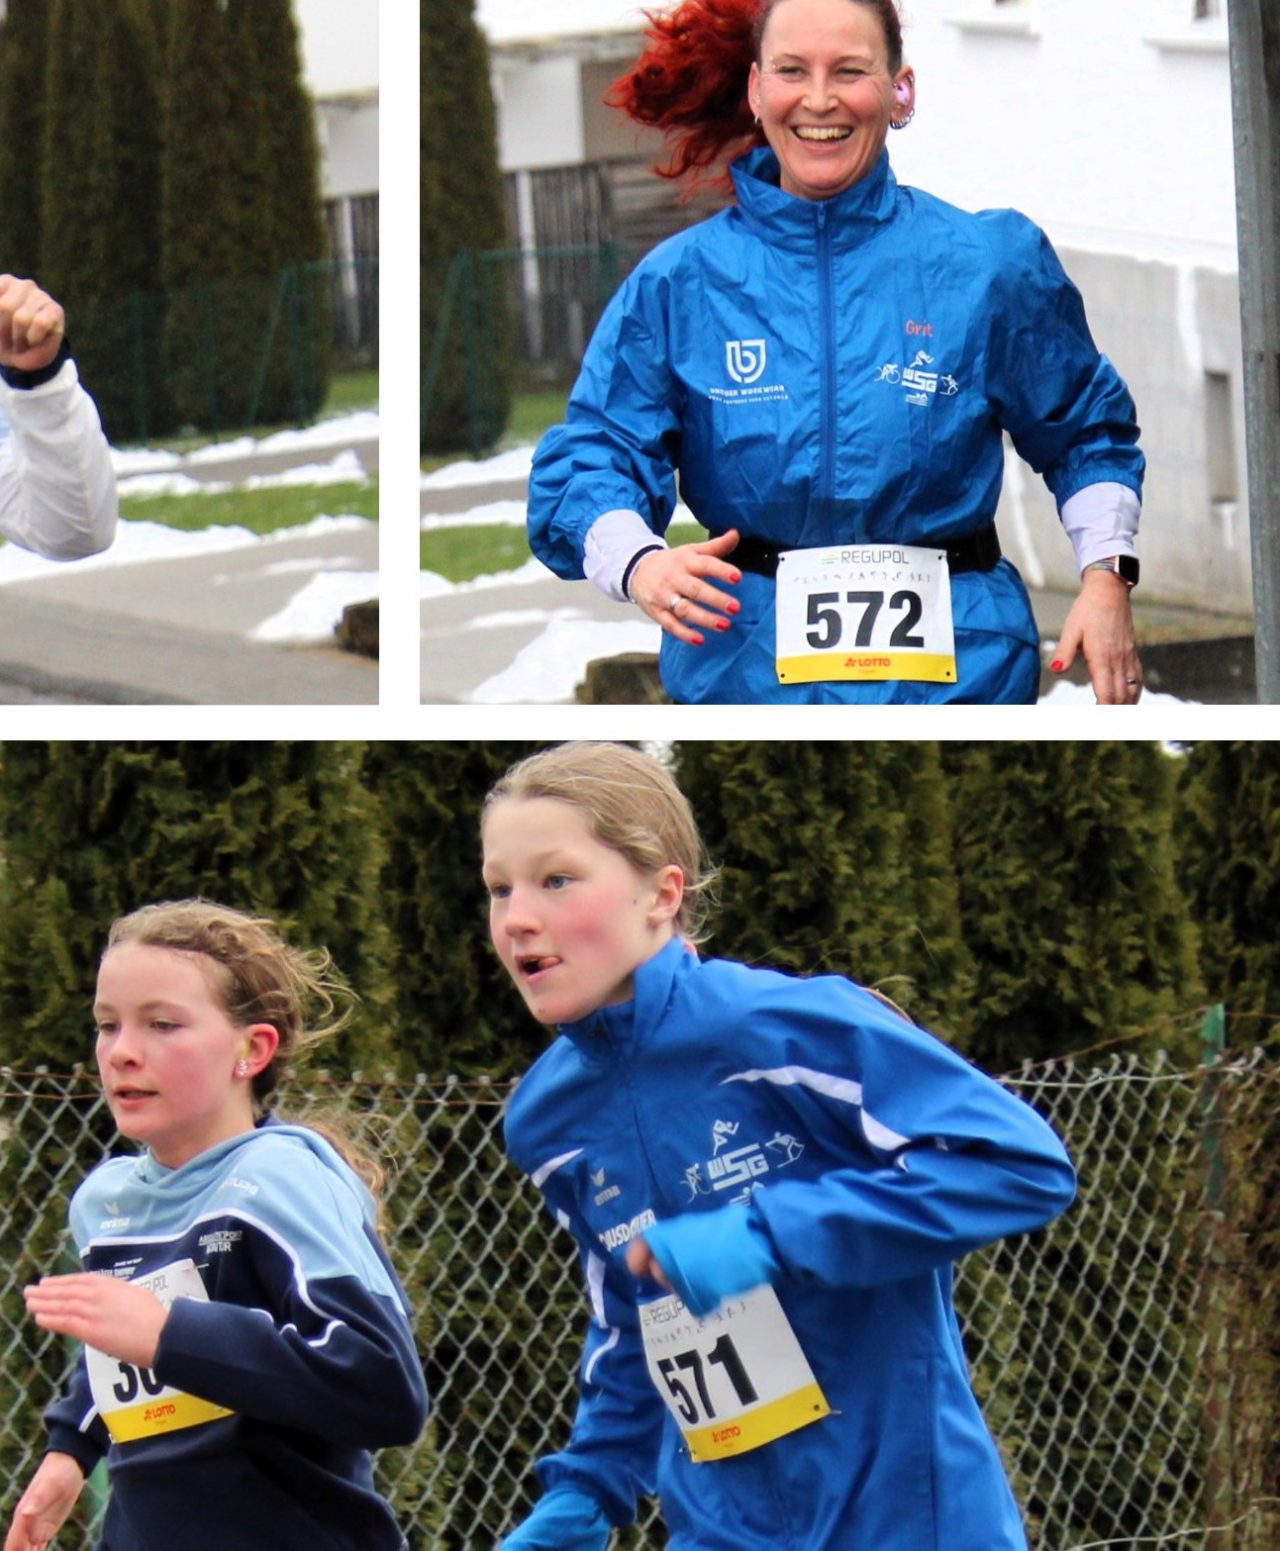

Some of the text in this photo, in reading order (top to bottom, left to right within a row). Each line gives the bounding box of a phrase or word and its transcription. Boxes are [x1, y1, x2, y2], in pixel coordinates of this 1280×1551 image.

[841, 550, 910, 565] REGUPOL
[806, 590, 925, 649] 572
[859, 657, 891, 667] LOTTO
[707, 1143, 770, 1191] WSG
[649, 1298, 684, 1325] REGUP
[657, 1333, 759, 1425] 571
[153, 1403, 176, 1417] LOTTO
